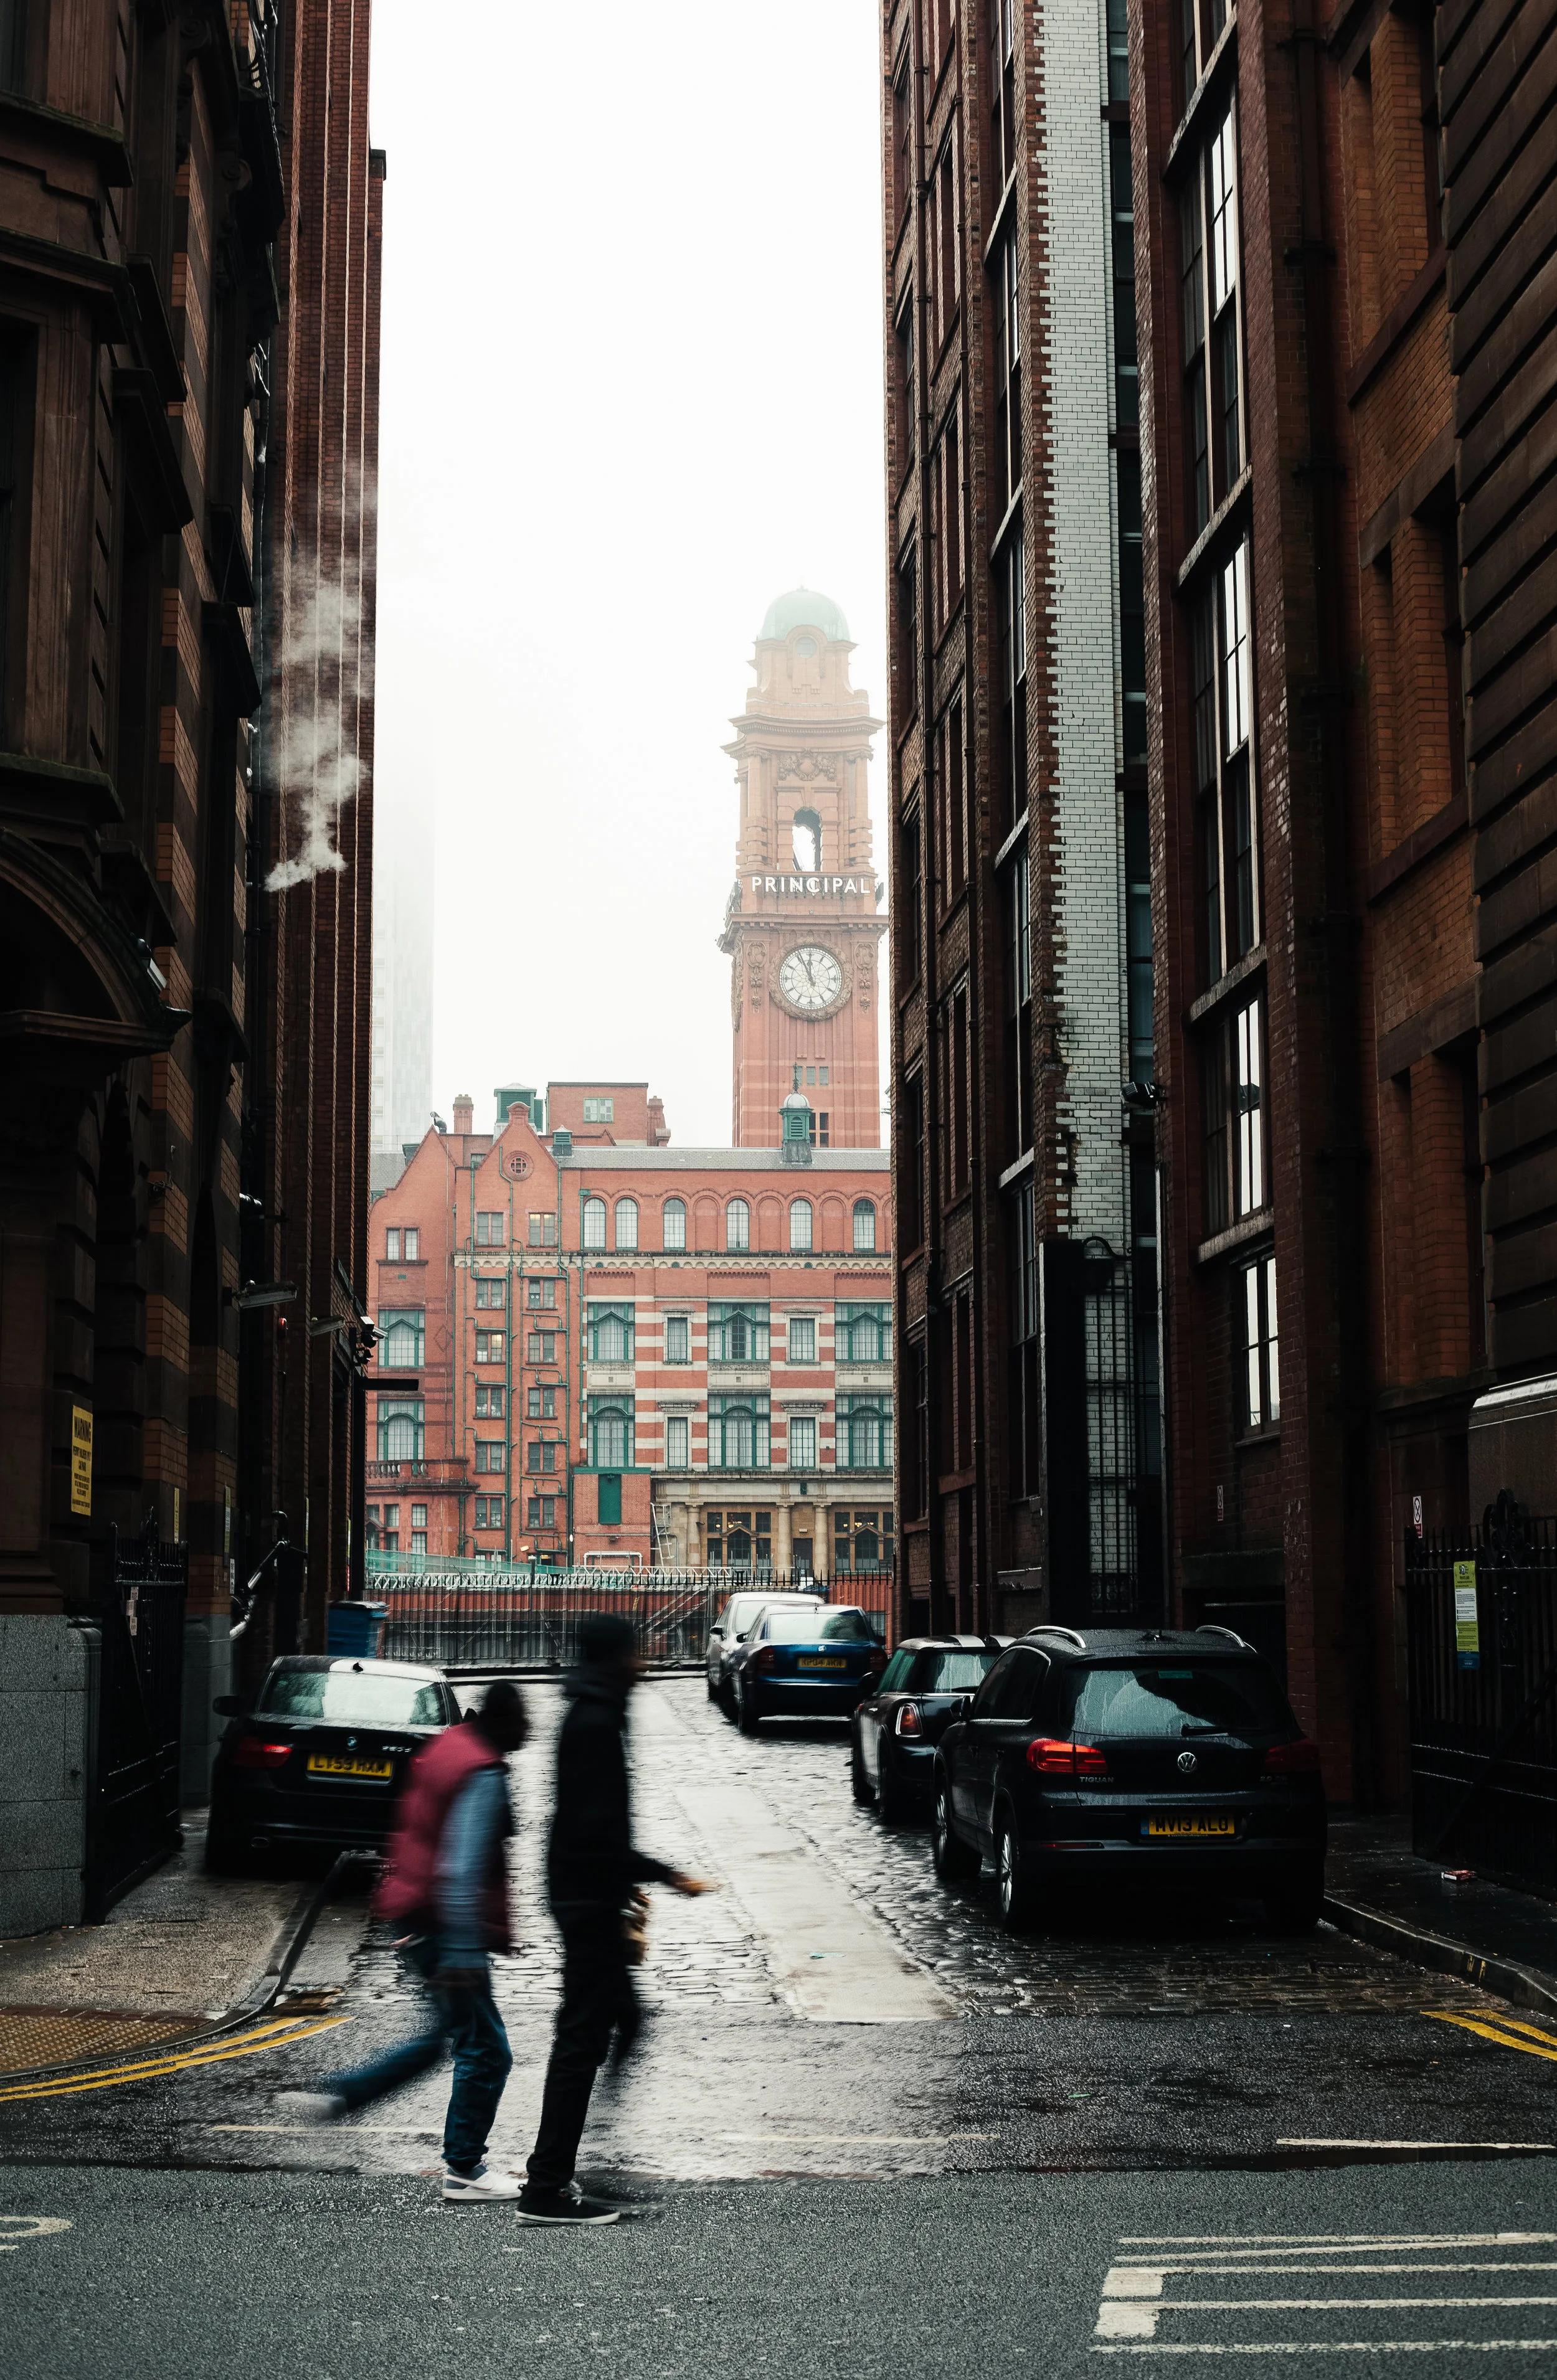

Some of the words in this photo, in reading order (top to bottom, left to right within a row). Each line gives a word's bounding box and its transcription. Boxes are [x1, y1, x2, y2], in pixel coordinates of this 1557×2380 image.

[752, 876, 871, 894] PRINCIPAL
[73, 1415, 91, 1443] WARNING
[1155, 1816, 1192, 1832] MV13
